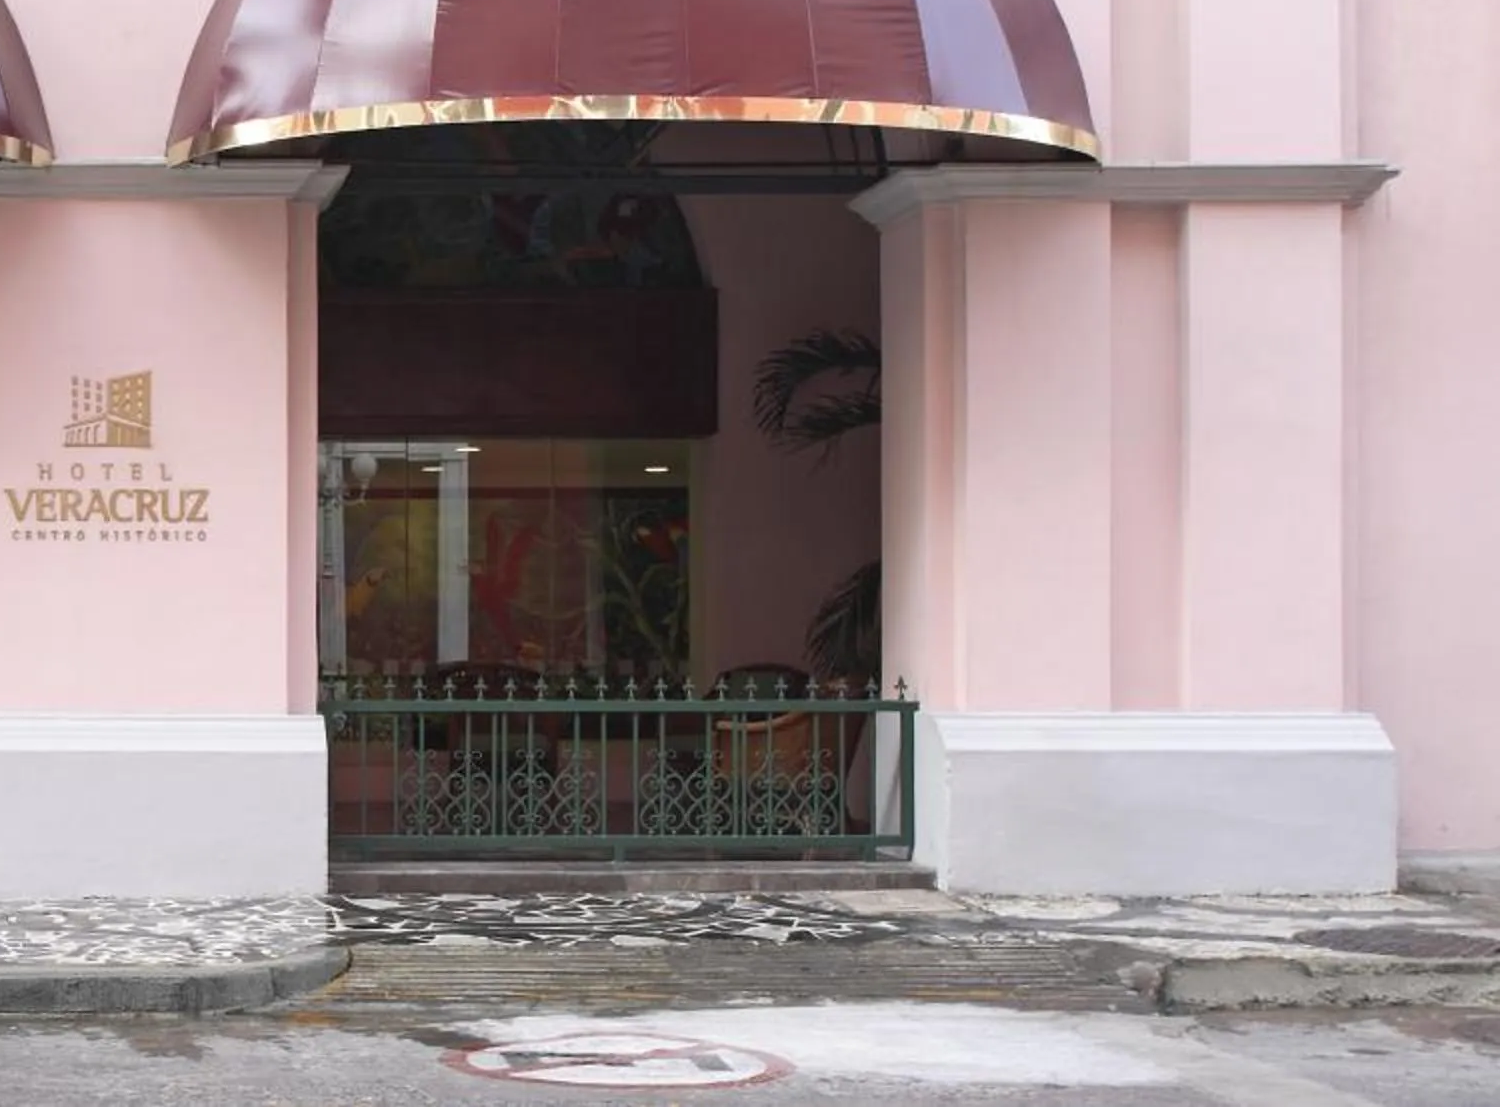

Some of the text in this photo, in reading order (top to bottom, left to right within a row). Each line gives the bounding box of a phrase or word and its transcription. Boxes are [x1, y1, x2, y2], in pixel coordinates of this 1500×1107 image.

[37, 463, 172, 481] HOTEL
[4, 489, 210, 523] VERACRUZ
[11, 528, 207, 542] CENTRO HISTÓRICO
